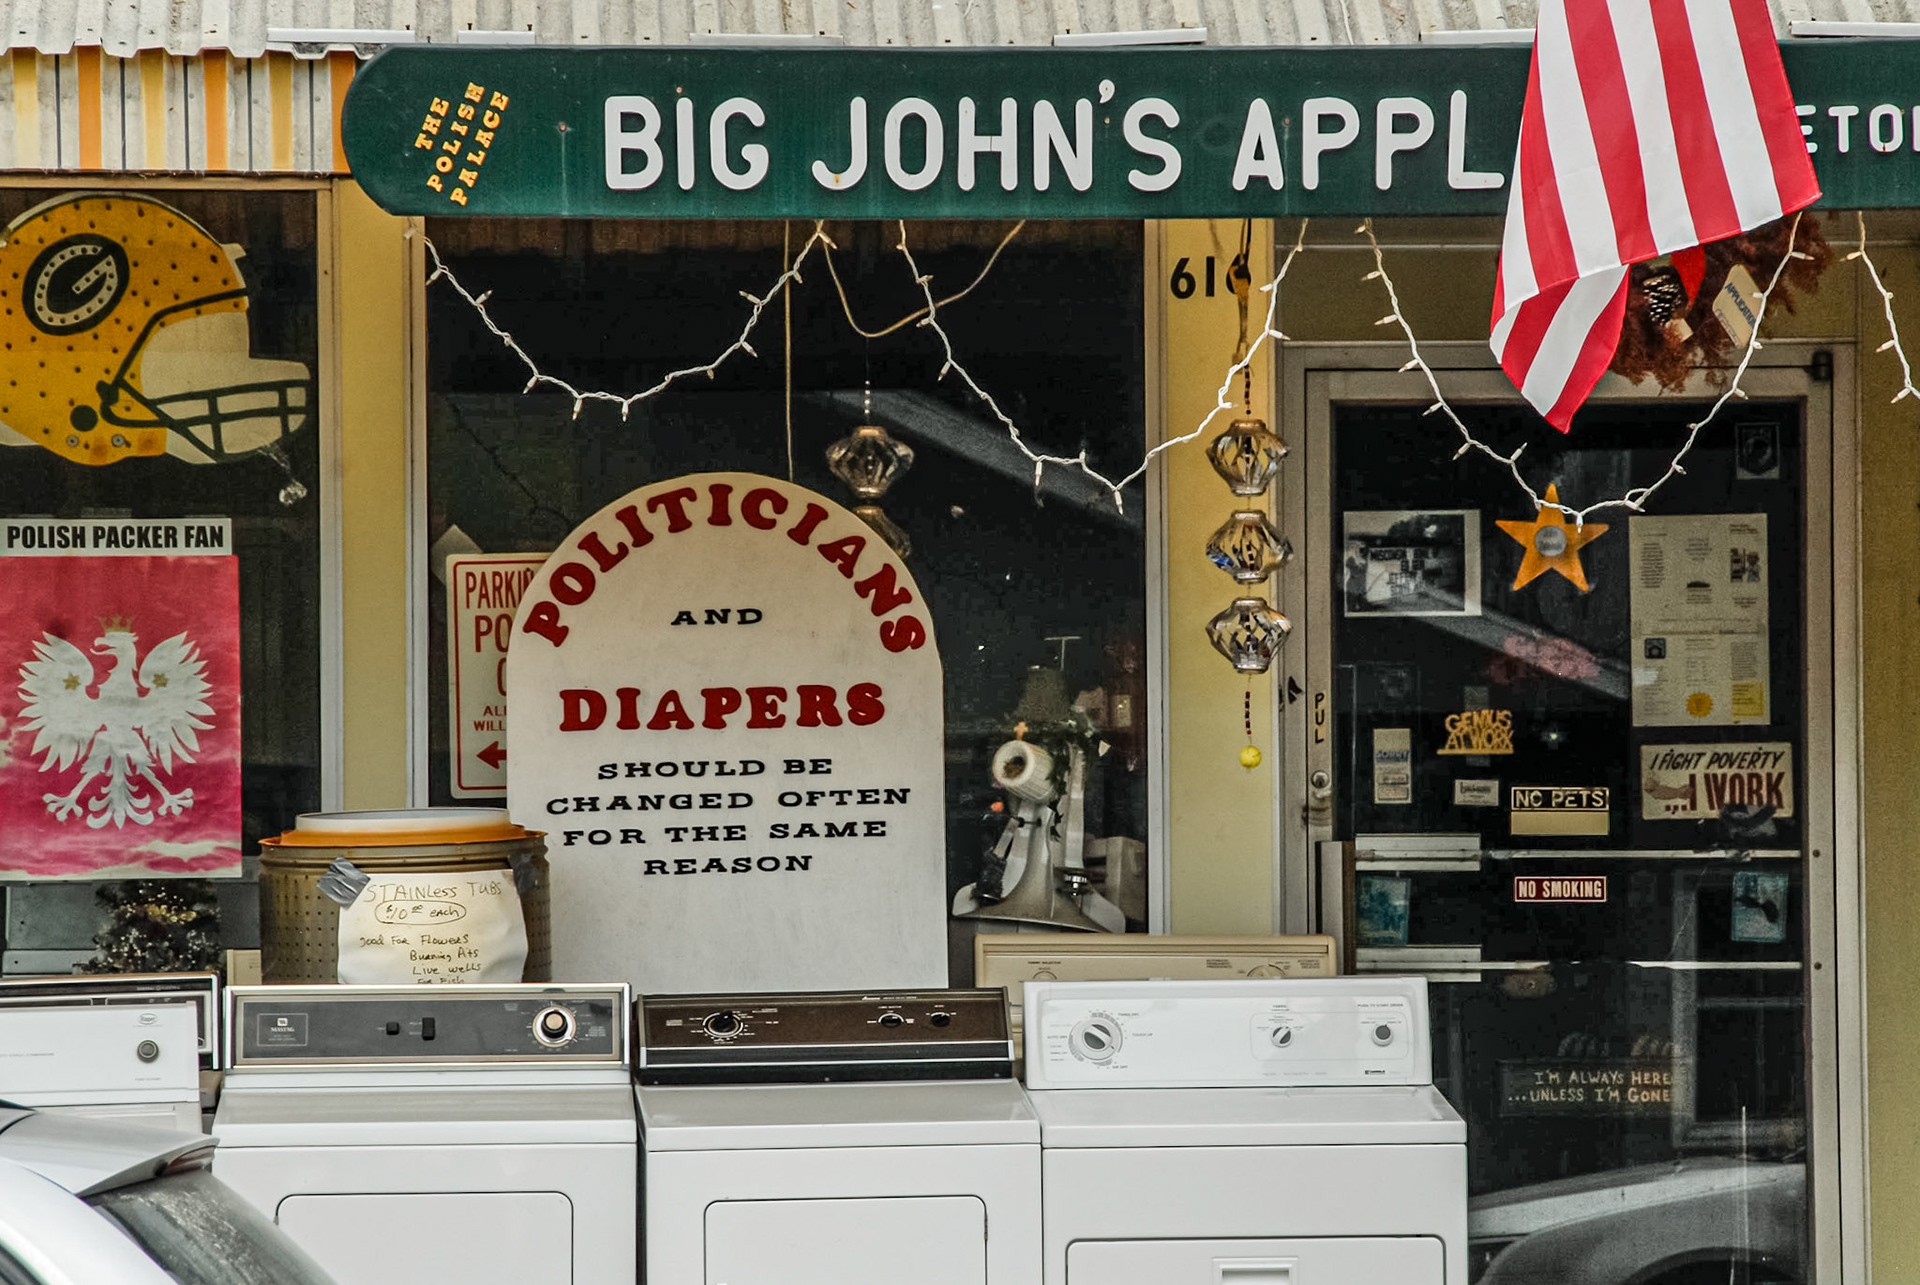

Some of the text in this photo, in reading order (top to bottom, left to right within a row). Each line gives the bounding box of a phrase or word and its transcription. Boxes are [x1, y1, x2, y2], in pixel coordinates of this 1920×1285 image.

[414, 97, 451, 151] THE
[605, 96, 769, 190] BIG
[811, 79, 1182, 191] JOHN'S
[426, 81, 486, 193] POLISH
[450, 91, 510, 206] PALACE
[7, 525, 224, 548] POLISH PACKER FAN
[522, 483, 927, 653] POLITICIANS
[670, 608, 764, 626] AND
[559, 682, 885, 731] DIAPERS
[597, 758, 832, 780] SHOULD BE
[1650, 750, 1786, 770] I FIGHT POVERTY
[546, 788, 911, 815] CHANGED OFTEN
[1516, 790, 1604, 807] NO PETS
[1704, 772, 1786, 811] WORK
[563, 821, 887, 846] FOR THE SAME
[643, 855, 813, 875] REASON
[1518, 880, 1602, 898] NO SMOKING
[1534, 1069, 1672, 1085] I'M ALWAYS HERE
[1594, 1087, 1620, 1102] I'M
